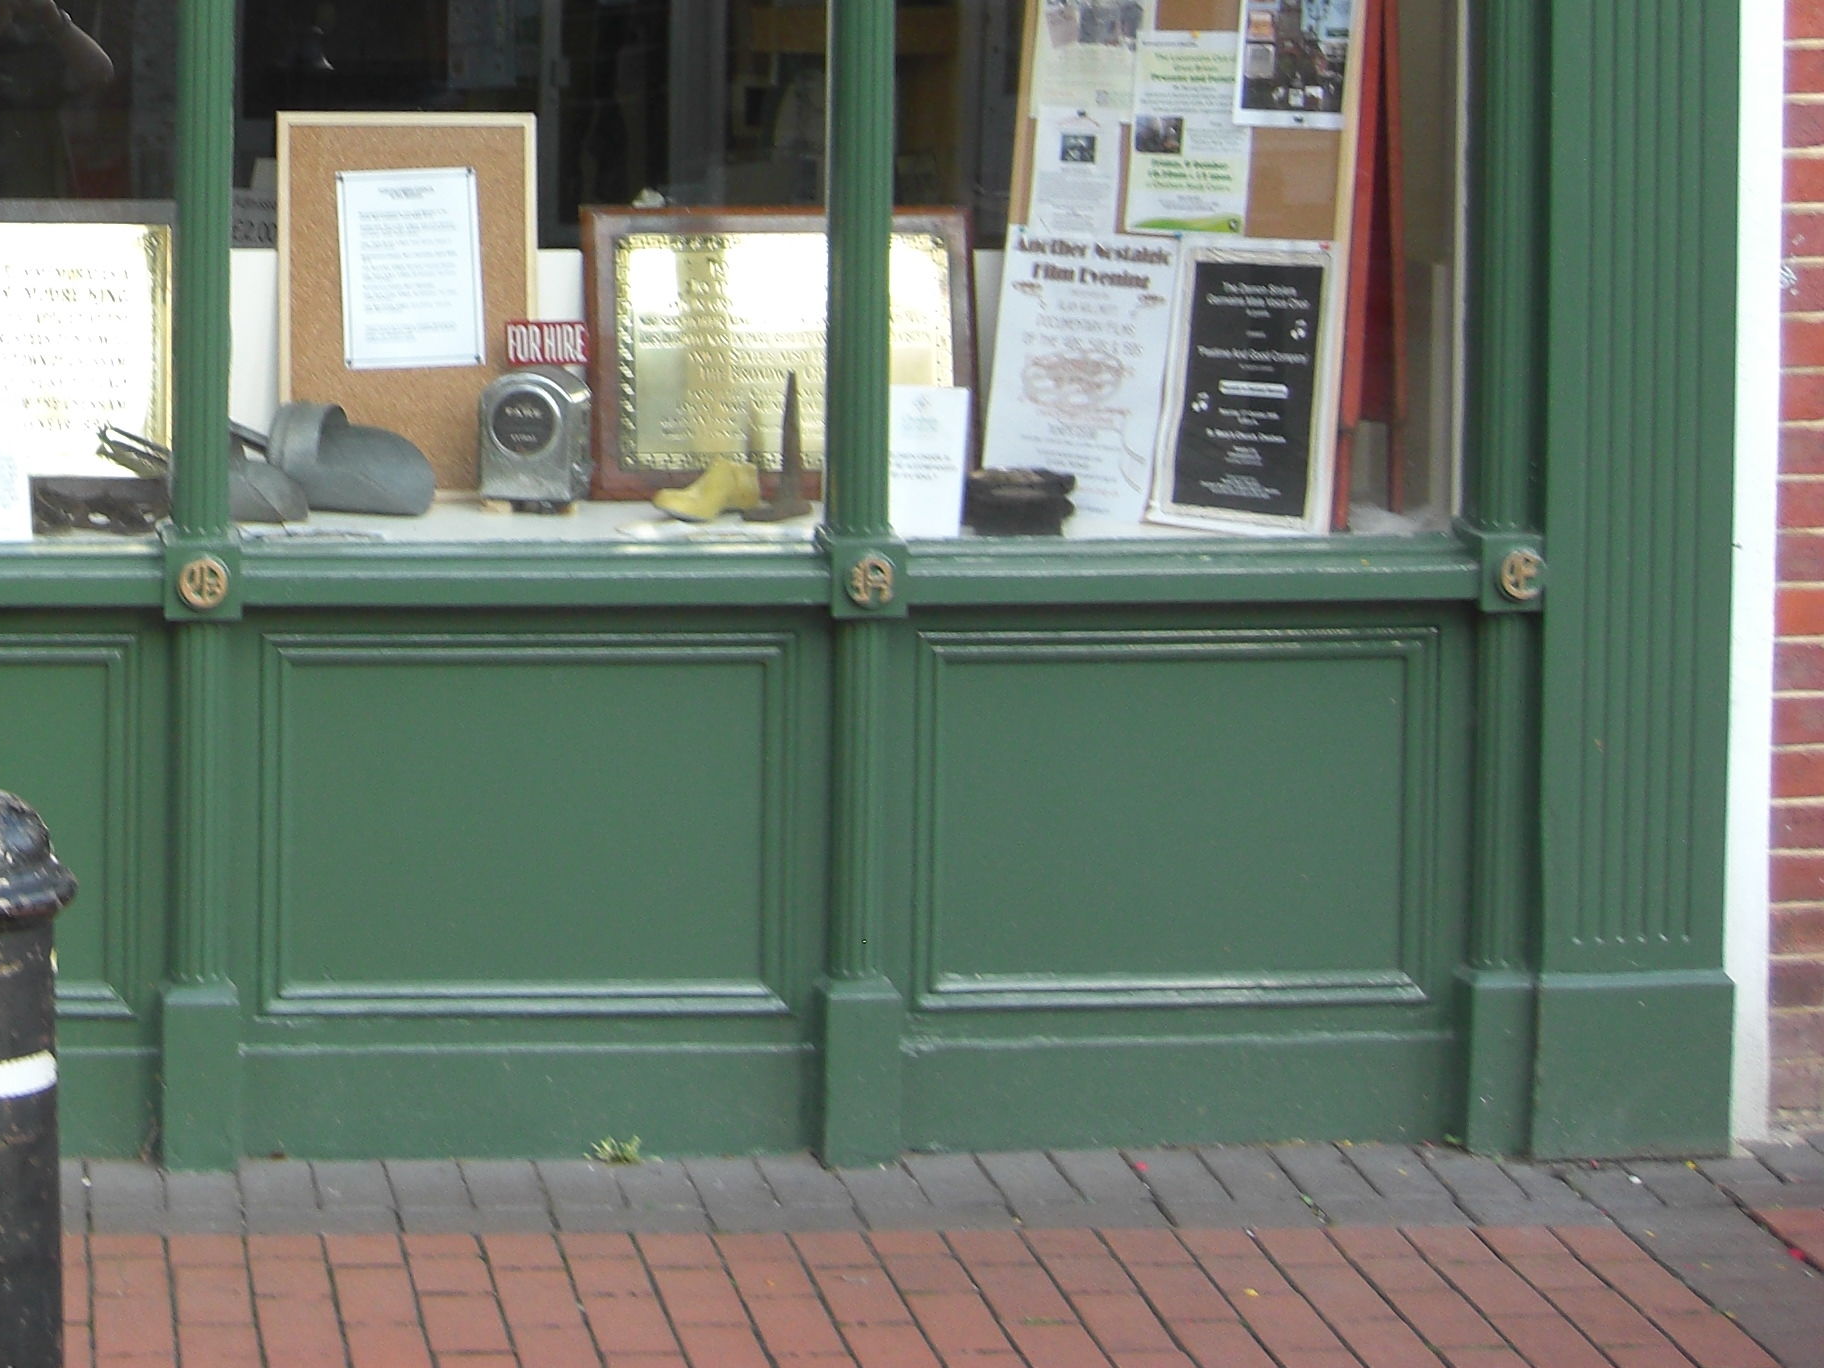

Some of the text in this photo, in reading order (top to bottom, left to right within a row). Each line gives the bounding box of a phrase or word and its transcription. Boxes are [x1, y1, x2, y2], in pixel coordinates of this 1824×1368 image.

[1016, 234, 1088, 259] Another
[1032, 261, 1151, 290] Film Evening
[507, 323, 587, 363] FOR HIRE
